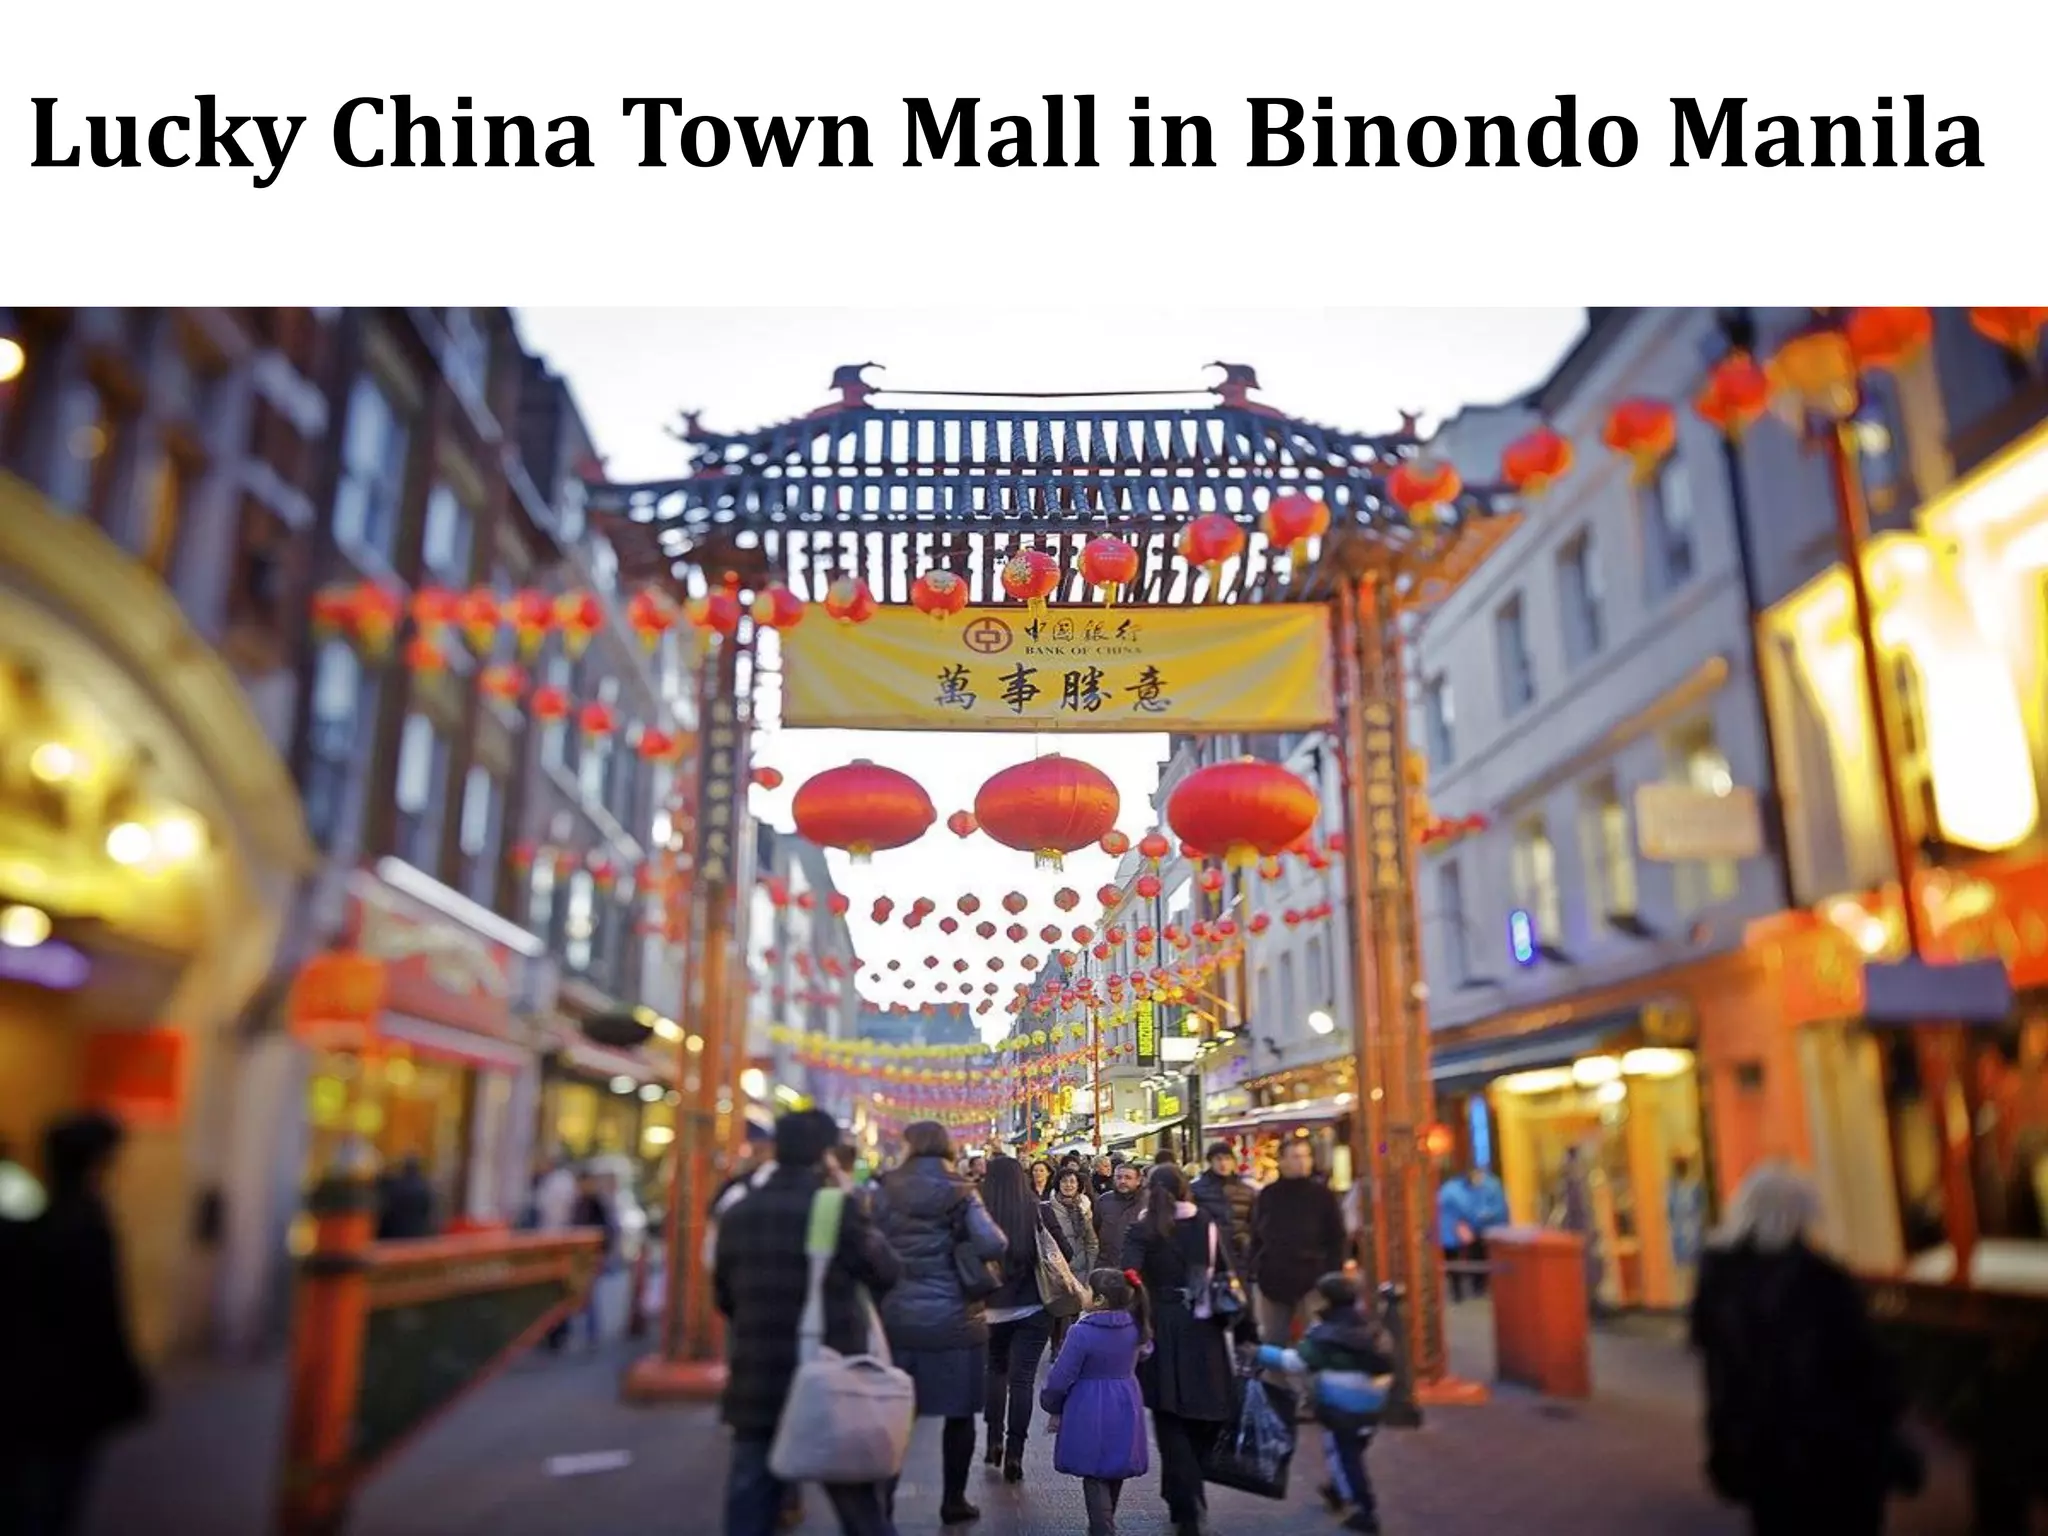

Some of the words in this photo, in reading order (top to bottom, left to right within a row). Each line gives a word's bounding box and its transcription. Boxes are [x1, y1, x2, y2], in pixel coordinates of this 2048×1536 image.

[1025, 646, 1064, 655] BANK
[1071, 646, 1087, 655] OF
[1096, 645, 1142, 655] CHINA
[934, 662, 1172, 714] 萬事勝意
